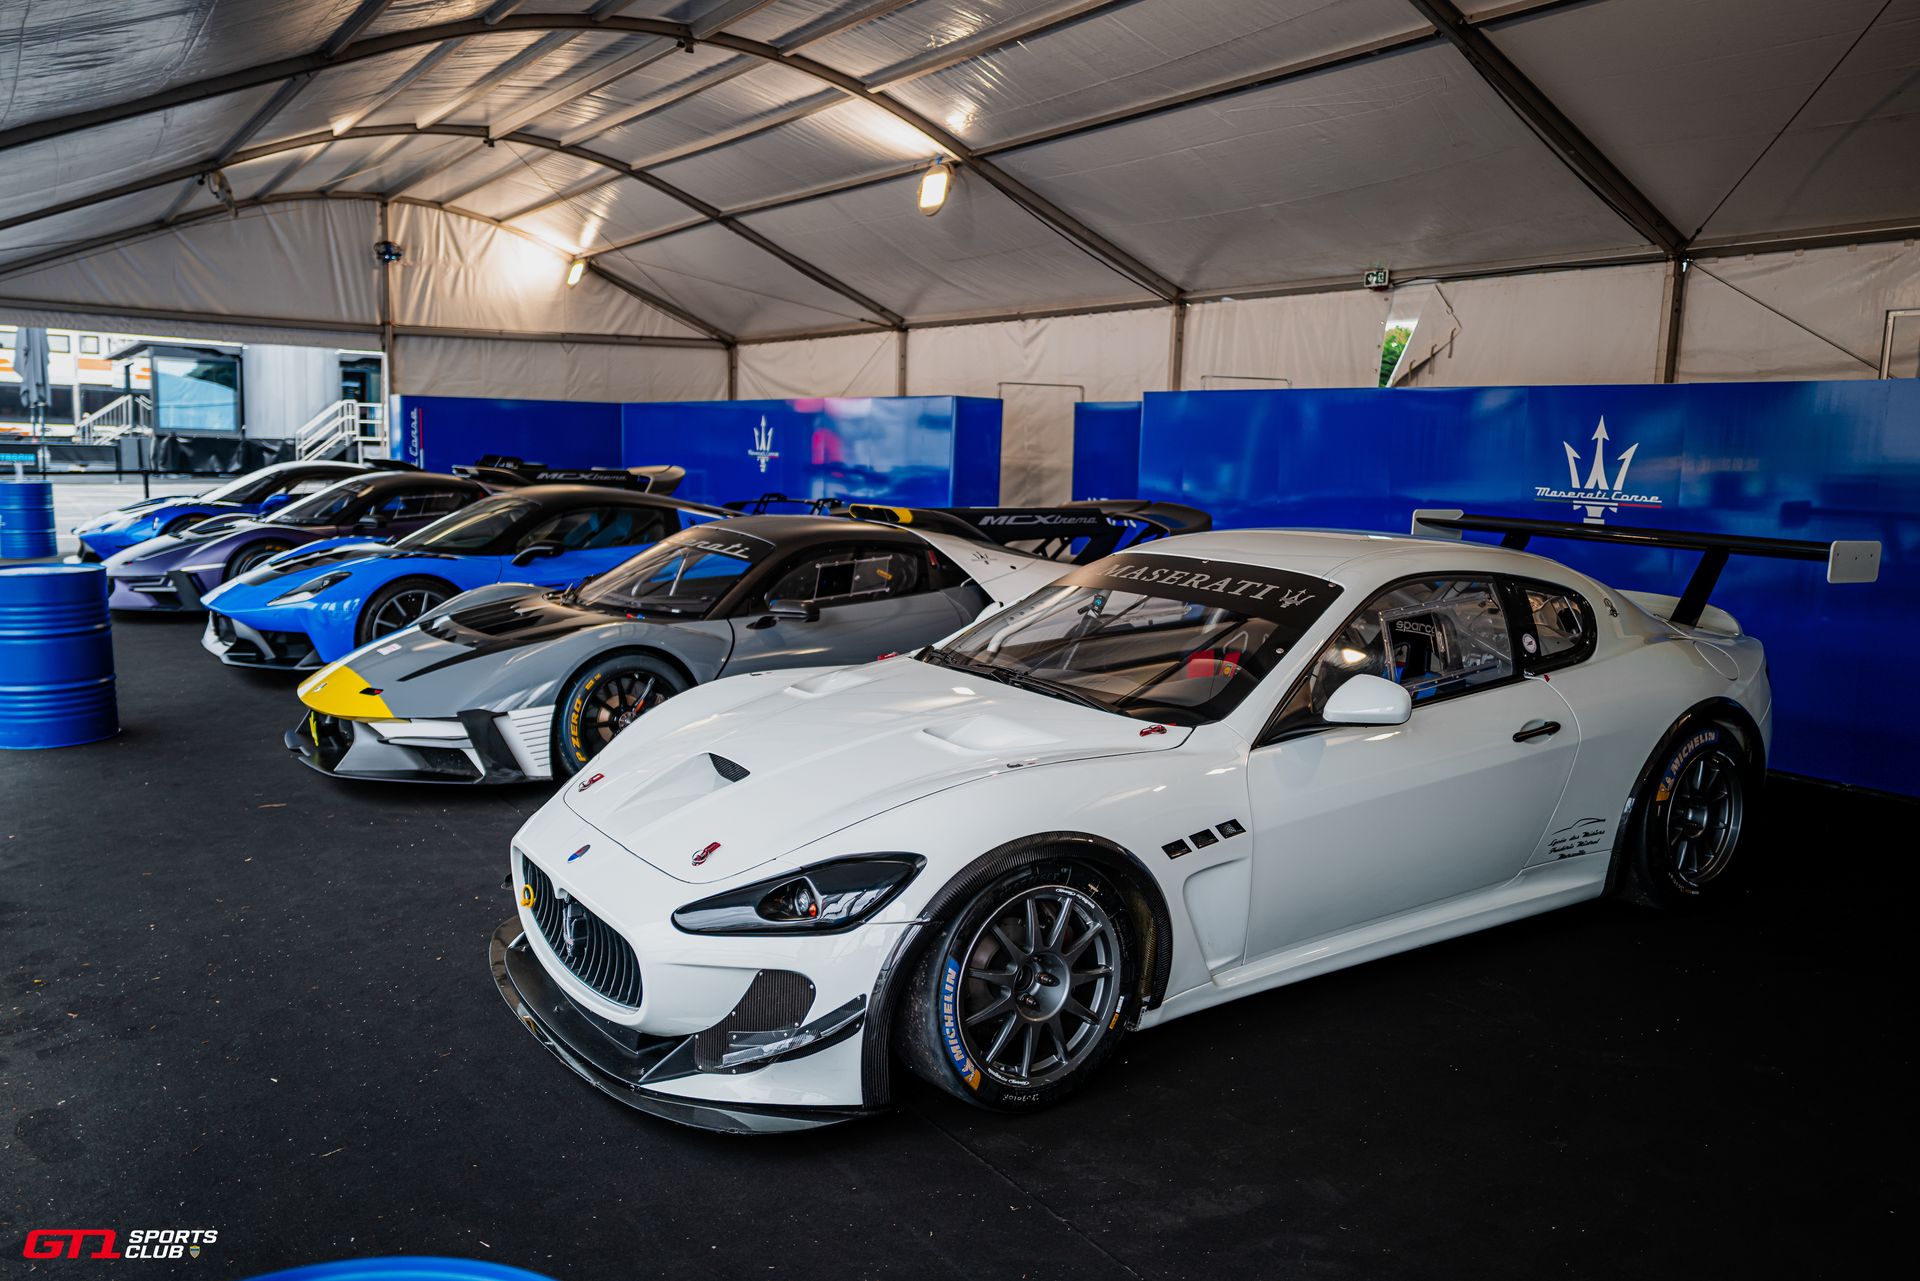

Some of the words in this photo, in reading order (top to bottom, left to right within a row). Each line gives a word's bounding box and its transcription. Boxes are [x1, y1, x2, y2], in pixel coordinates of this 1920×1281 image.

[1534, 486, 1610, 501] Maserati
[1610, 491, 1663, 504] Corse
[1097, 563, 1281, 601] MASERATI
[570, 696, 583, 749] ZERO
[1669, 730, 1717, 773] MICHELIN
[943, 967, 965, 1062] MICHELIN
